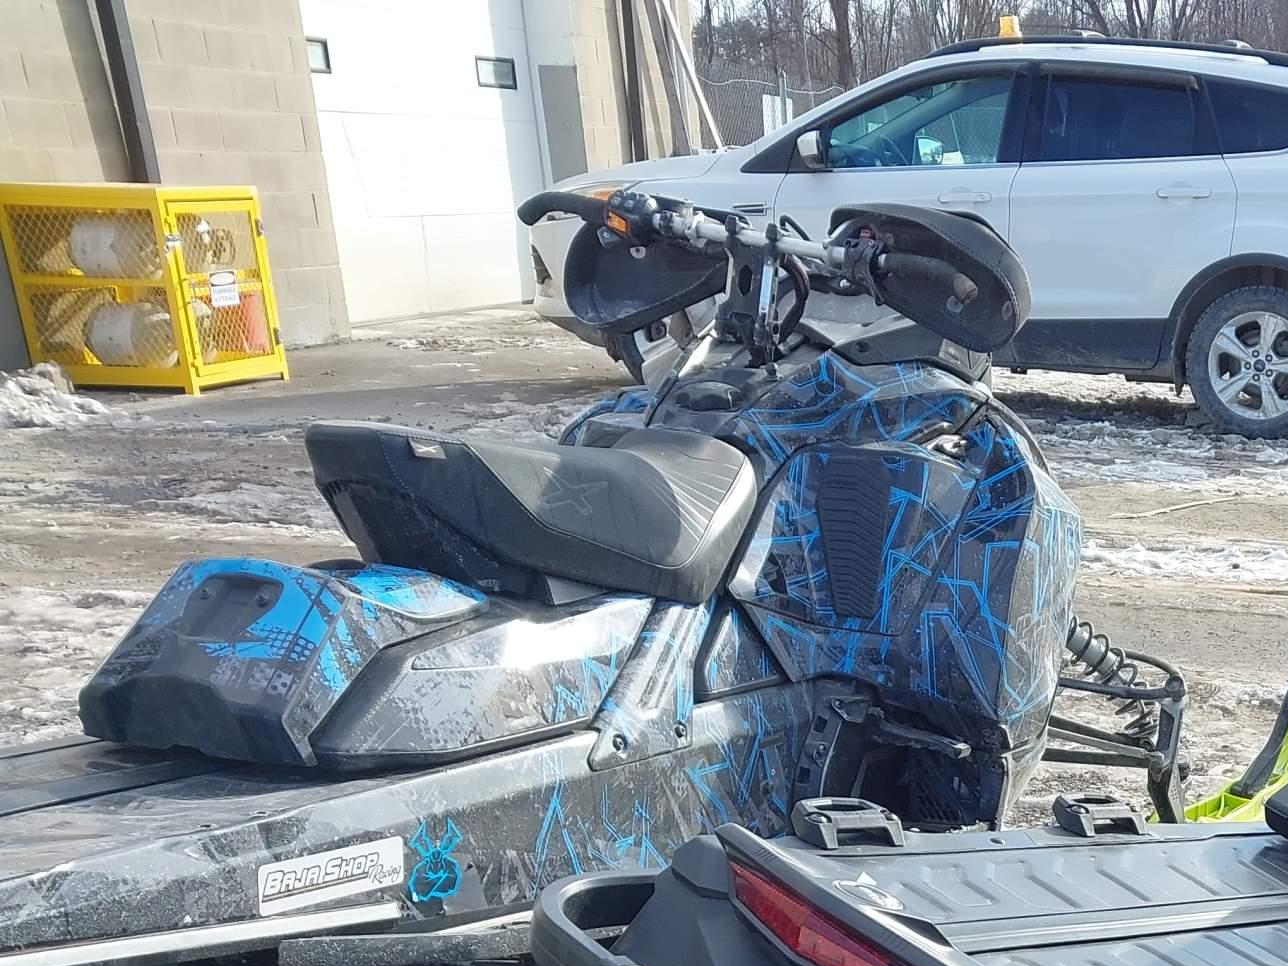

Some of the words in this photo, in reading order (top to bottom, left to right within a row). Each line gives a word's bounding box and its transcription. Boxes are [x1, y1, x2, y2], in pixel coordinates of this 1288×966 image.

[262, 864, 323, 898] BAJA
[323, 851, 380, 885] SHOP
[369, 863, 402, 885] Racing
